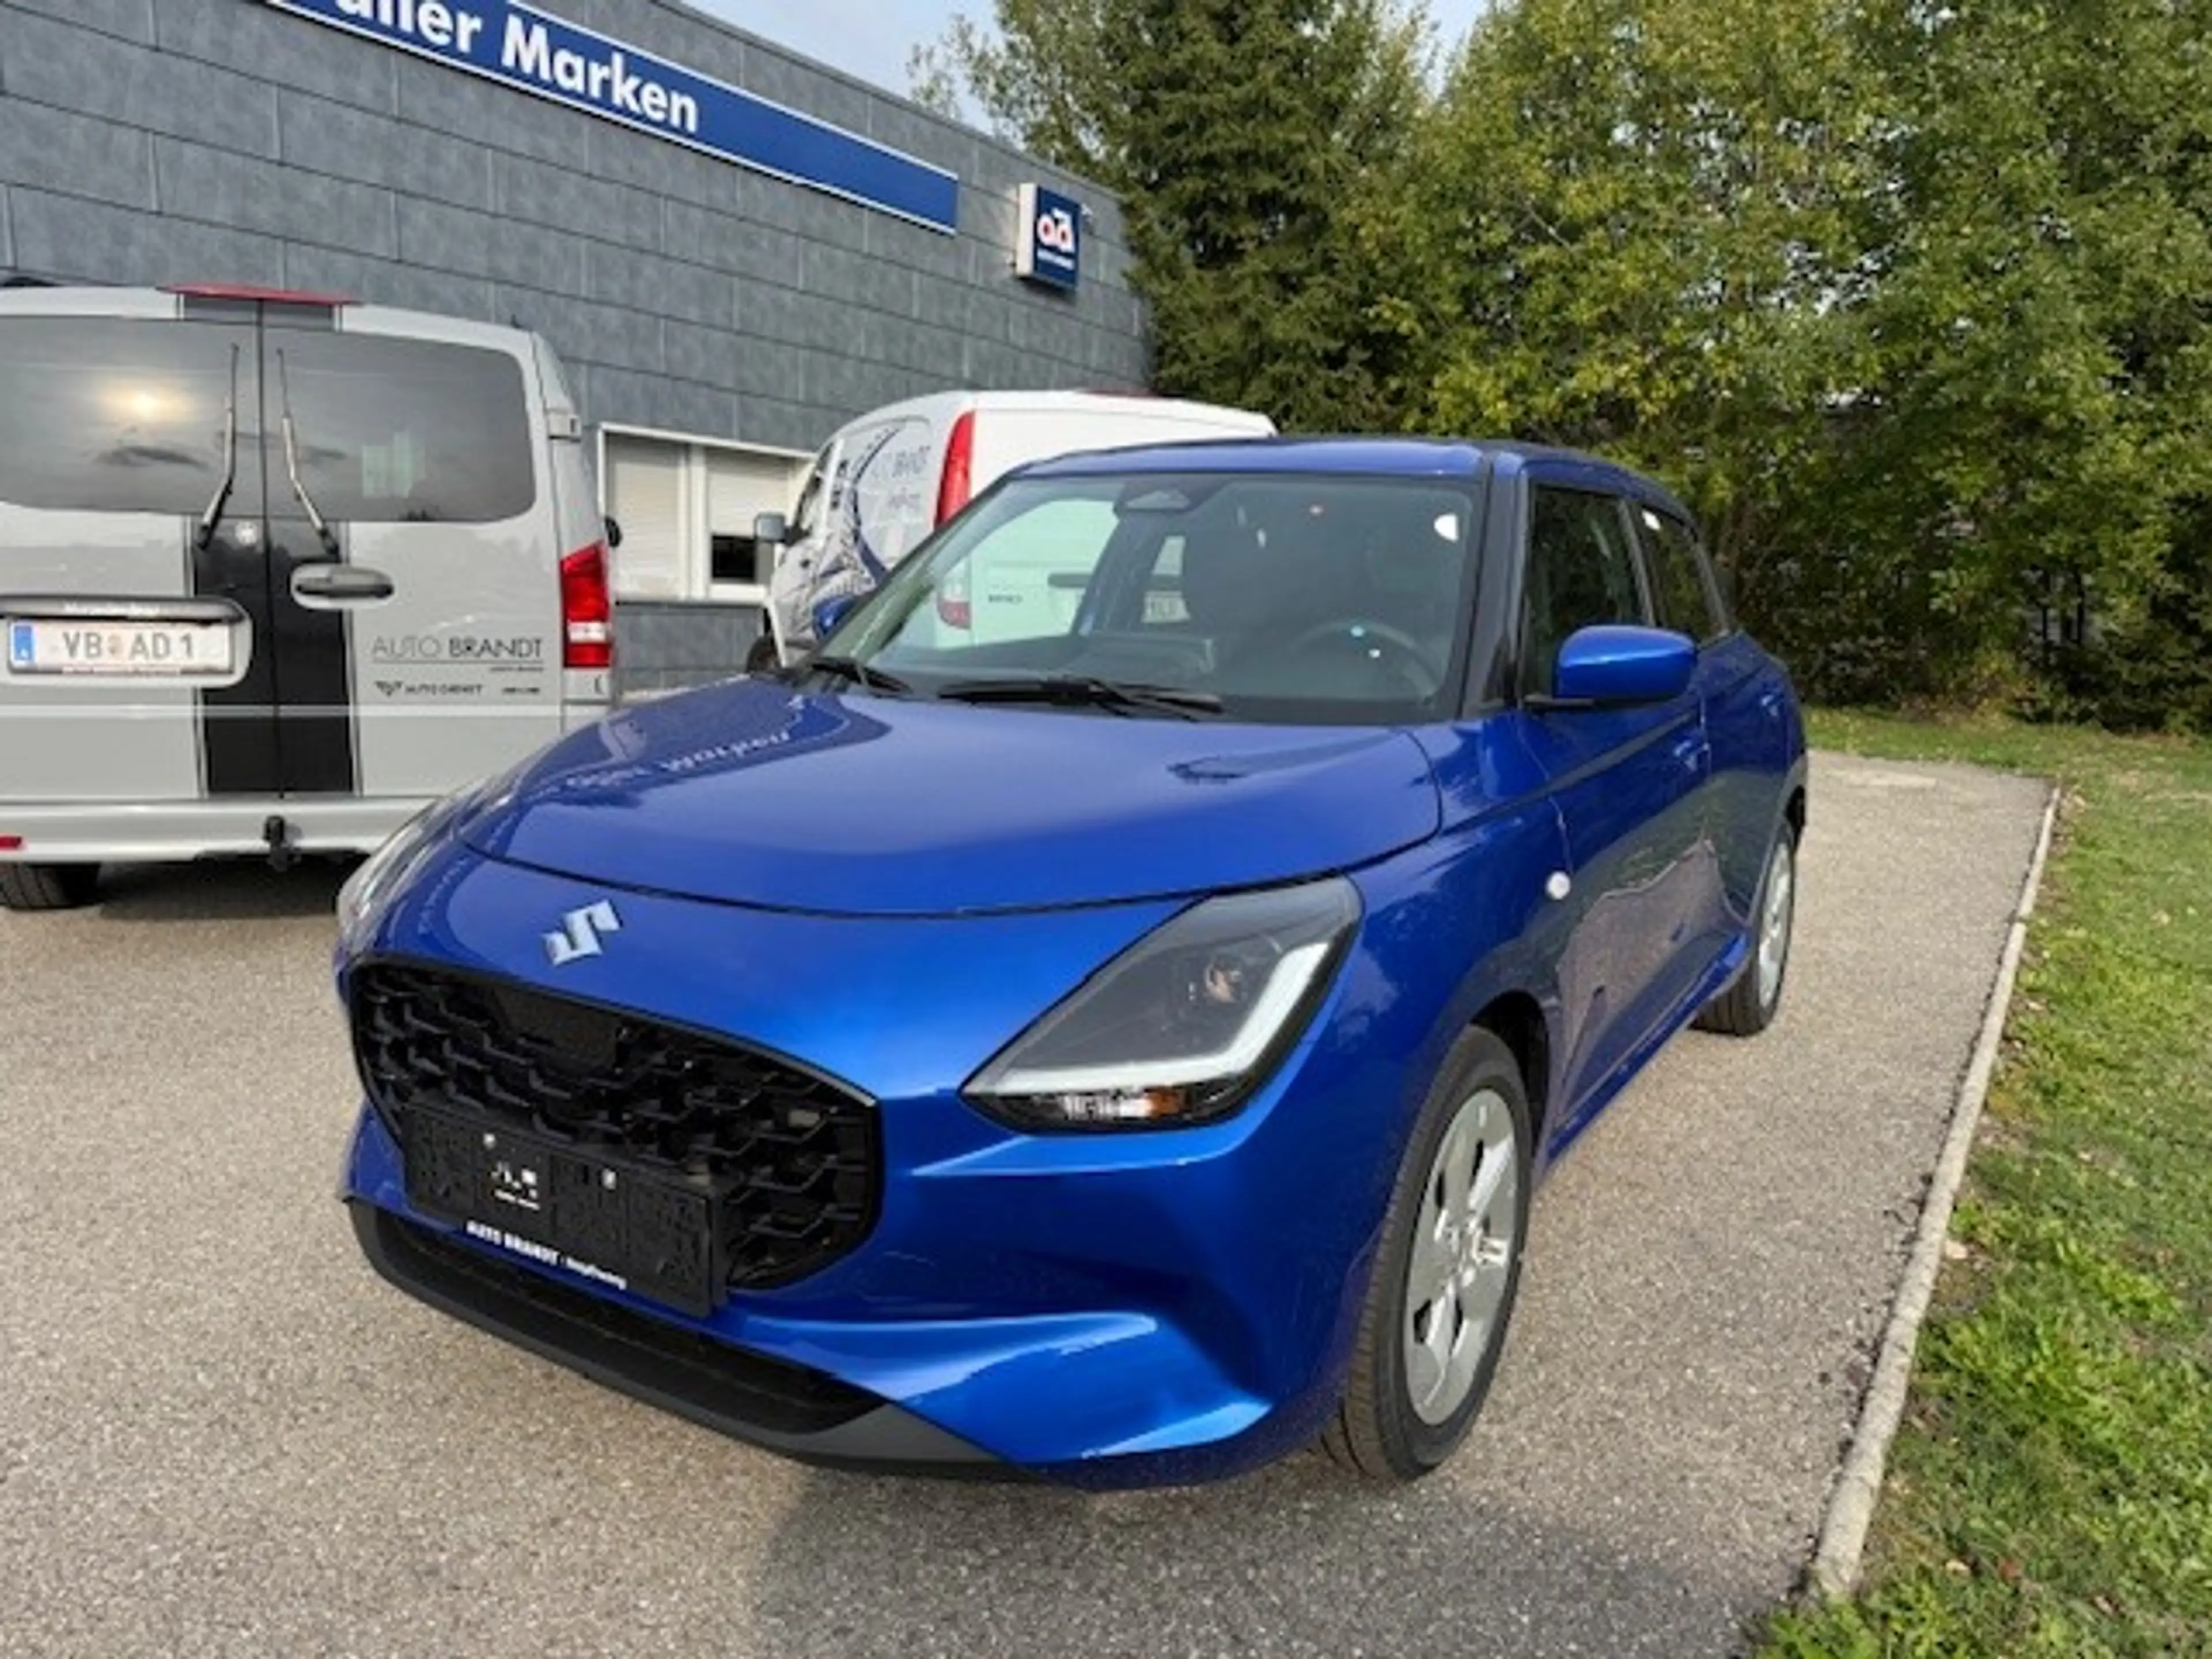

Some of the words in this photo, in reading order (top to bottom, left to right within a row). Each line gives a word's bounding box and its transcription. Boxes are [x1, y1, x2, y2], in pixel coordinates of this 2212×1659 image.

[501, 13, 699, 133] Marken
[62, 630, 103, 660] VB
[128, 632, 171, 661] AD
[179, 632, 194, 660] 1
[373, 635, 441, 658] AUTO
[448, 637, 543, 658] BRANDT
[503, 1232, 560, 1266] BRANDT
